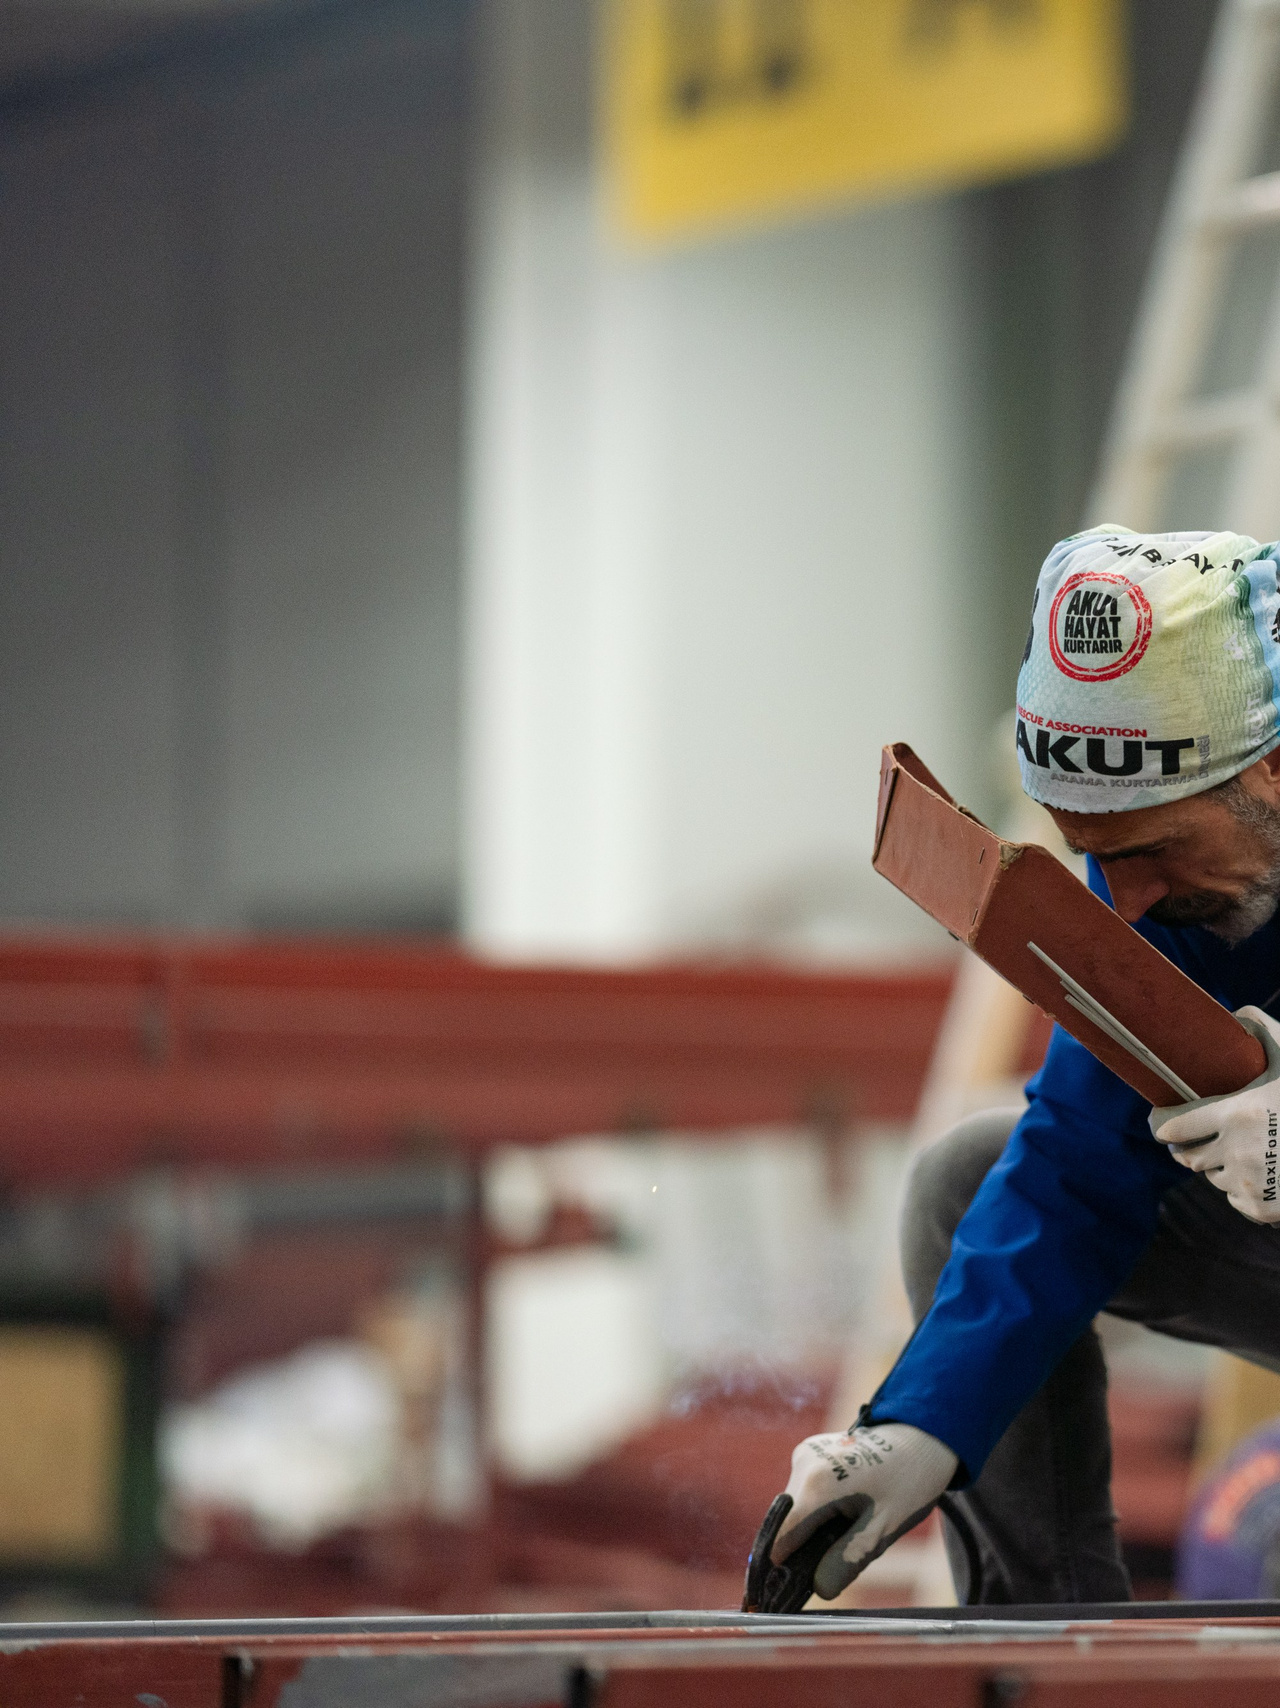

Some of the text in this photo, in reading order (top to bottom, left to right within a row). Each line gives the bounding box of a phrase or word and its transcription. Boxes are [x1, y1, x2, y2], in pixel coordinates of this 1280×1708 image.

[1064, 616, 1121, 639] HAYAT
[1063, 639, 1123, 654] KURTARIR
[1046, 719, 1147, 738] ASSOCIATION
[1016, 718, 1195, 776] AKUT
[1050, 772, 1198, 788] ARAMA KURTARMA
